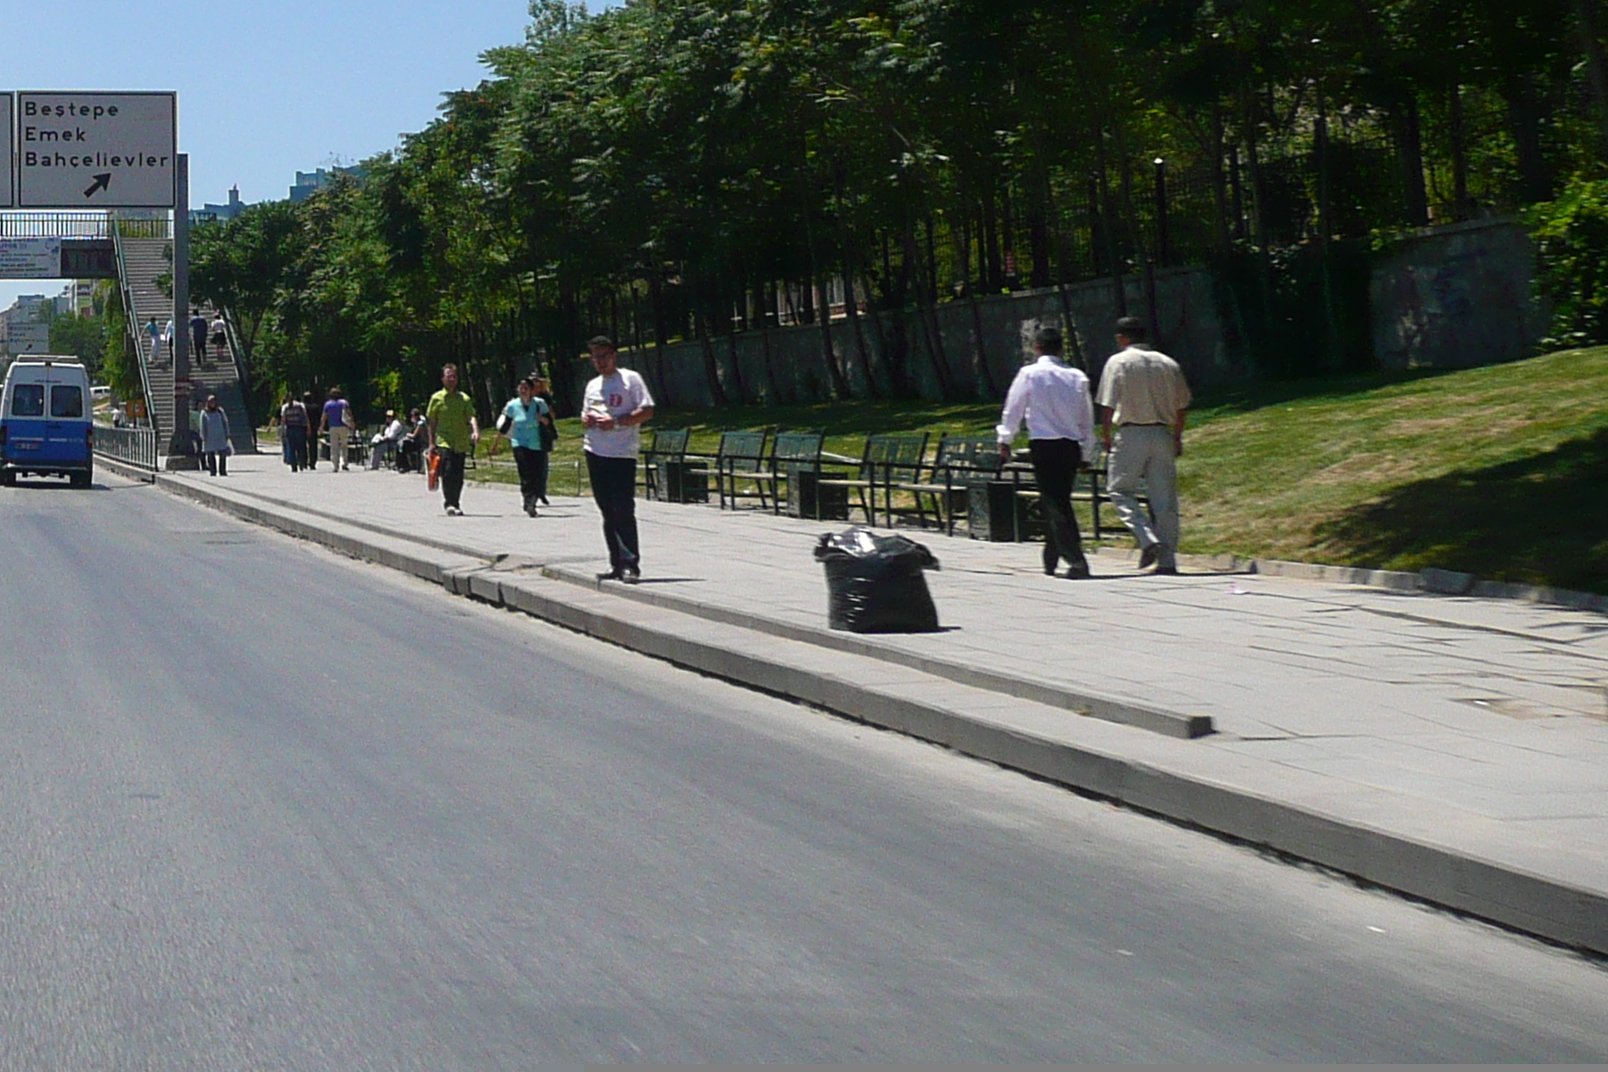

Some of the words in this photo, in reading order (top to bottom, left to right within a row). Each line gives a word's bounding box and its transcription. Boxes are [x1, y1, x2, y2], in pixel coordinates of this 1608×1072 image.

[24, 101, 119, 120] Beştepe
[24, 127, 87, 142] Emek
[24, 151, 169, 168] Bahçelievler
